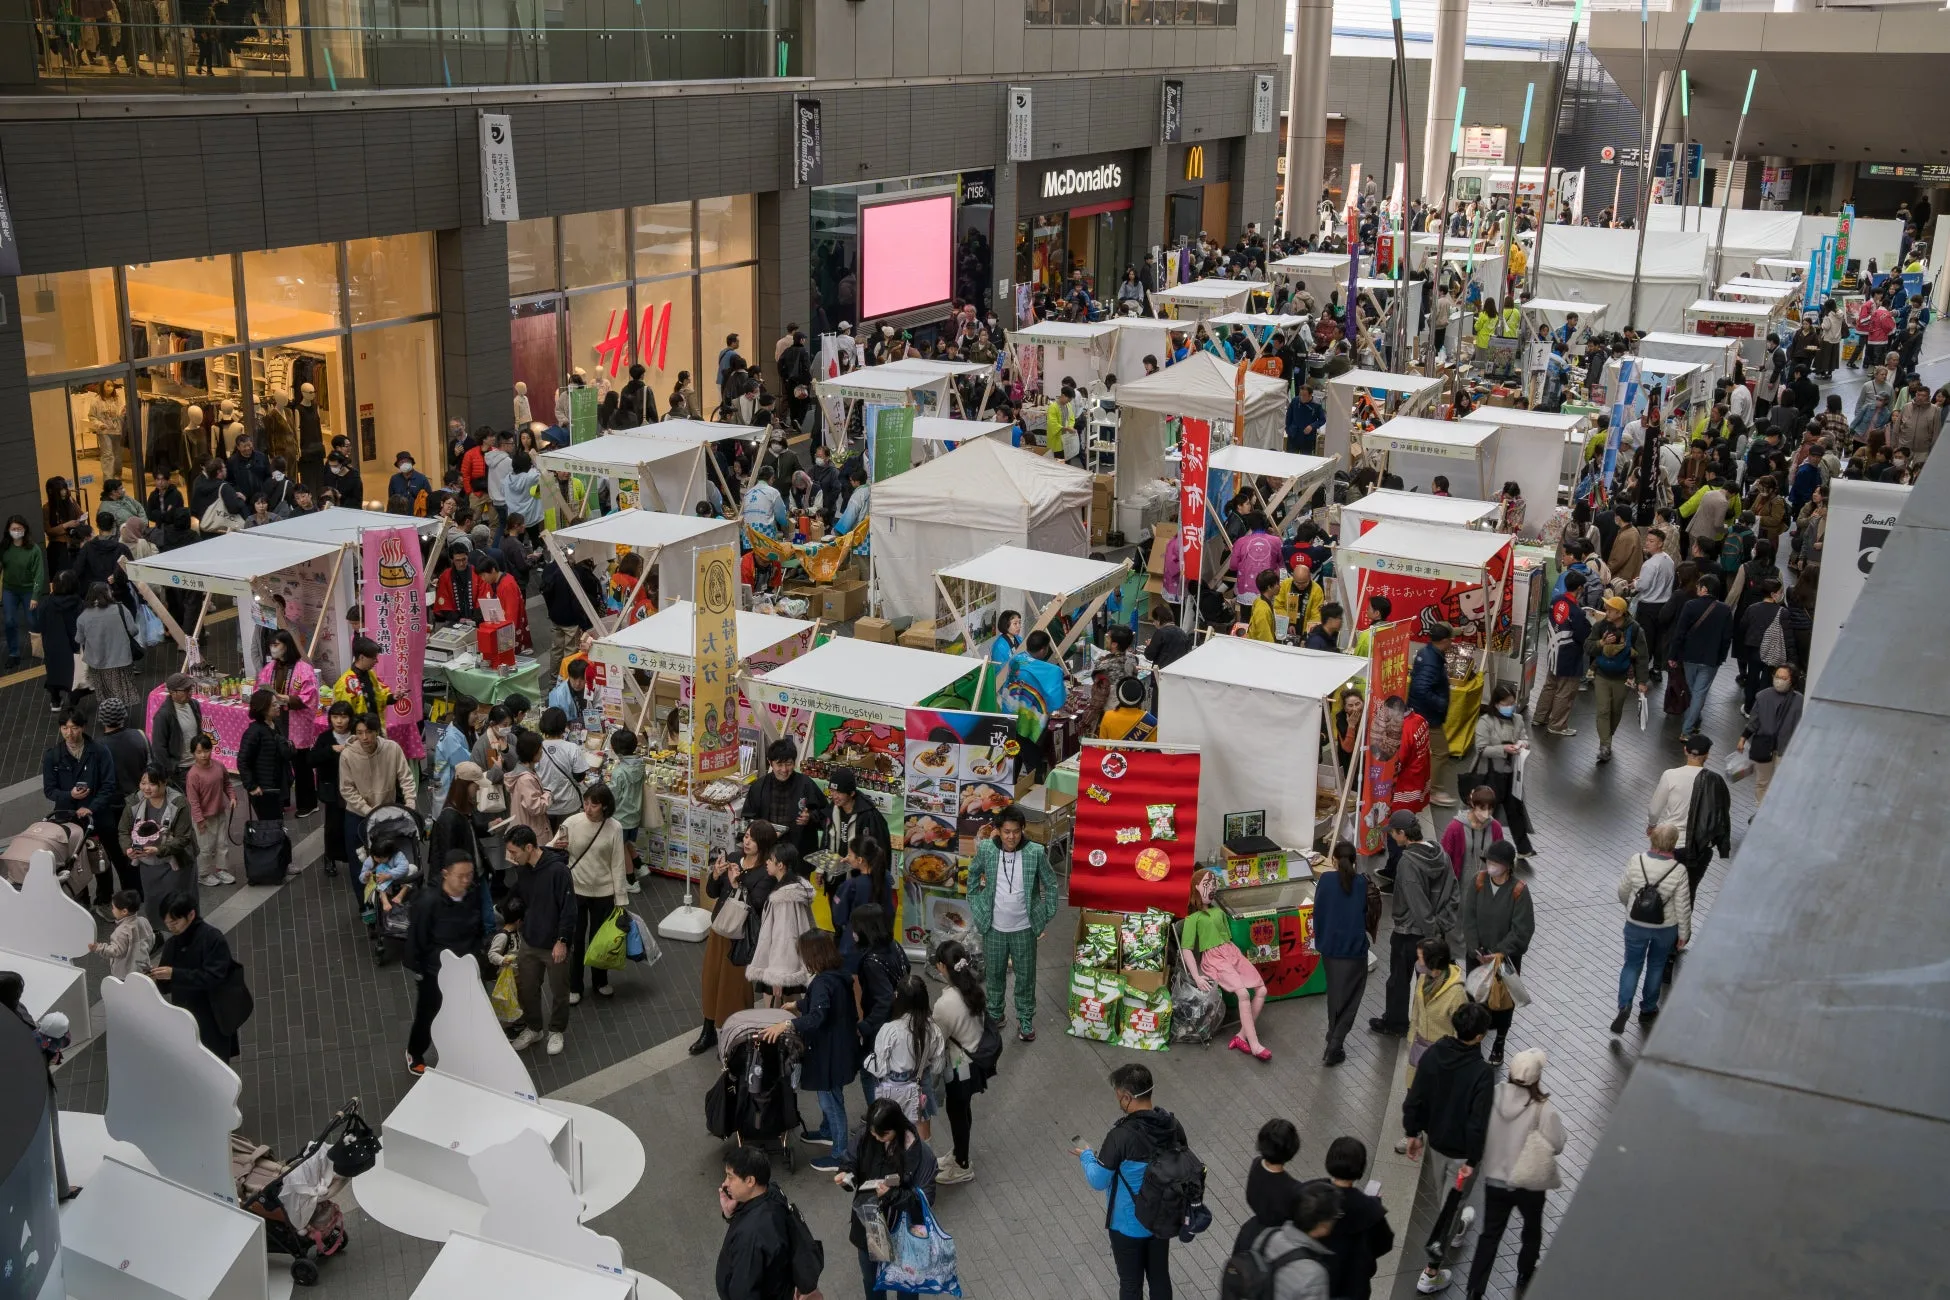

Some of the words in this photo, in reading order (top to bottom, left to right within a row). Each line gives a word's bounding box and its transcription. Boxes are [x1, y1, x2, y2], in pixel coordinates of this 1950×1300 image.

[1044, 164, 1122, 198] McDonald's
[1388, 562, 1440, 576] 大分県中津市
[182, 579, 204, 588] 大分県
[1366, 585, 1437, 598] 中津においで
[410, 590, 420, 632] 日本一の
[791, 696, 840, 712] 大分県大分市
[842, 706, 882, 720] (LogStyle)
